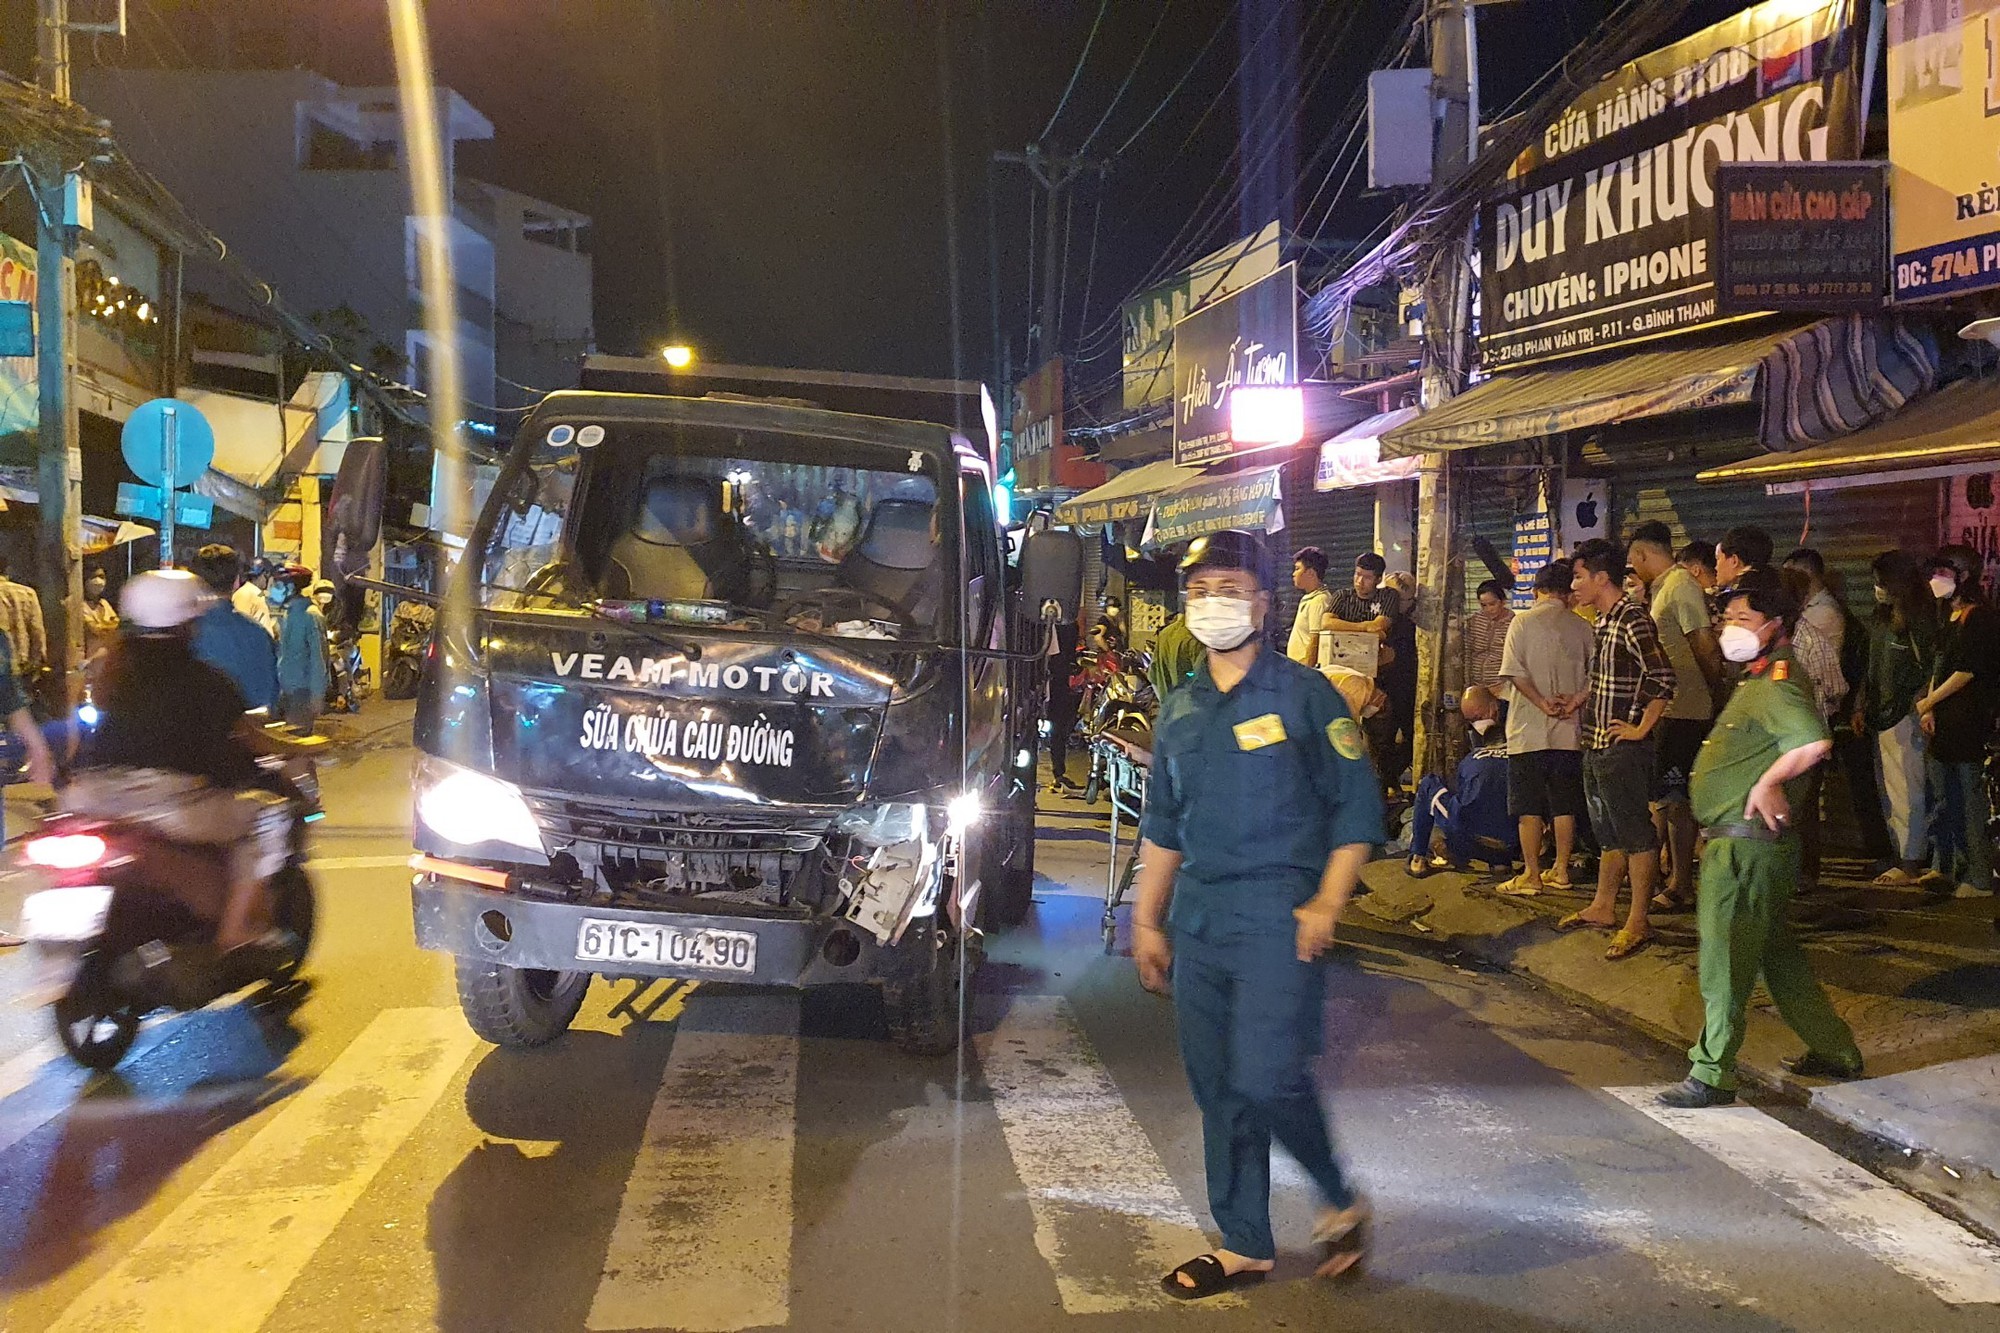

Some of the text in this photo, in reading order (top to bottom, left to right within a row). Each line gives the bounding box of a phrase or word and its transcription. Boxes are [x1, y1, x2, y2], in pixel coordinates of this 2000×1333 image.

[1544, 105, 1590, 158] CỬA
[1596, 78, 1665, 138] HÀNG
[1495, 179, 1573, 272] DUY
[1503, 239, 1706, 322] CHUYÊN: IPHONE
[1898, 261, 1927, 289] ĐC:
[1931, 247, 1979, 283] 274A
[1501, 342, 1523, 361] 274B
[1525, 338, 1552, 356] PHAN
[1554, 331, 1575, 350] VĂN
[1578, 328, 1594, 346] TRỊ
[1602, 320, 1623, 340] P.11
[1632, 308, 1674, 331] Q.BÌNH
[551, 652, 835, 697] VEAM MOTOR
[580, 703, 619, 750] SỮA
[683, 707, 723, 760] CẦU
[726, 713, 794, 767] ĐƯỜNG
[583, 924, 750, 968] 61C-104.90
